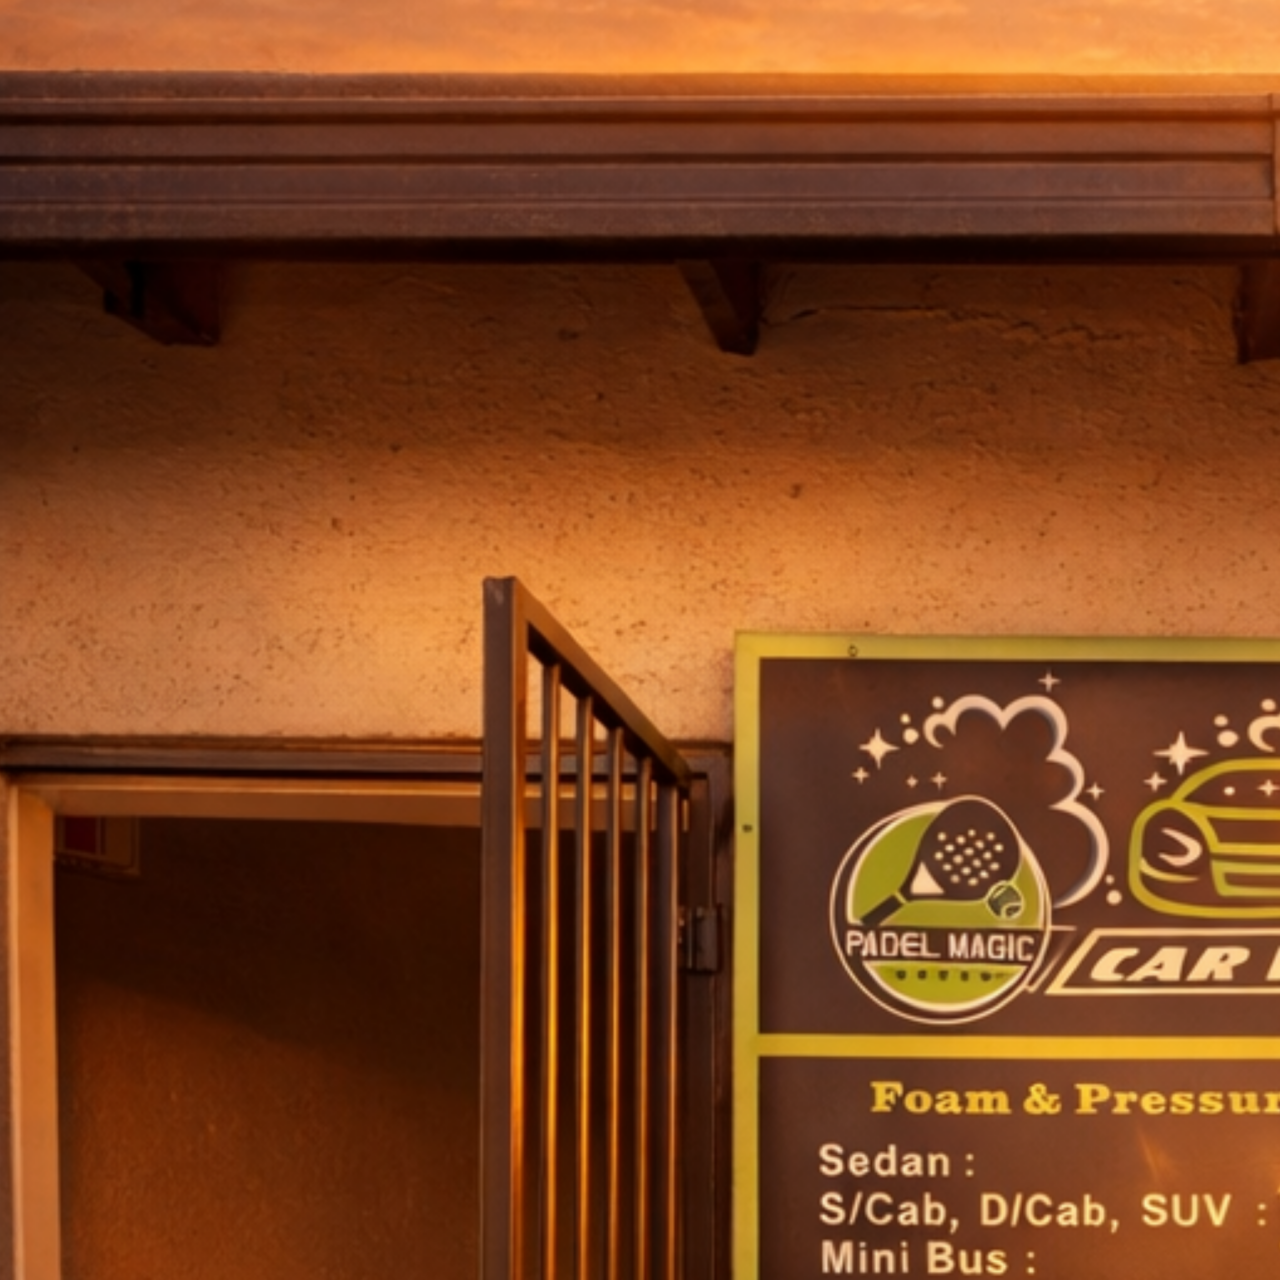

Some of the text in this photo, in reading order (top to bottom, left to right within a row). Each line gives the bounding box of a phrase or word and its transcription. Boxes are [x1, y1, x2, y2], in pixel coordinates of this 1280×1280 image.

[846, 930, 1035, 962] PADEL MAGIC
[1089, 945, 1251, 983] CAR
[873, 1083, 1011, 1115] Foam
[1025, 1084, 1062, 1115] &
[819, 1144, 951, 1178] Sedan
[820, 1193, 960, 1234] S/Cab,
[981, 1194, 1121, 1234] D/Cab,
[1142, 1194, 1233, 1228] SUV
[822, 1241, 910, 1275] Mini
[928, 1242, 1009, 1276] Bus
